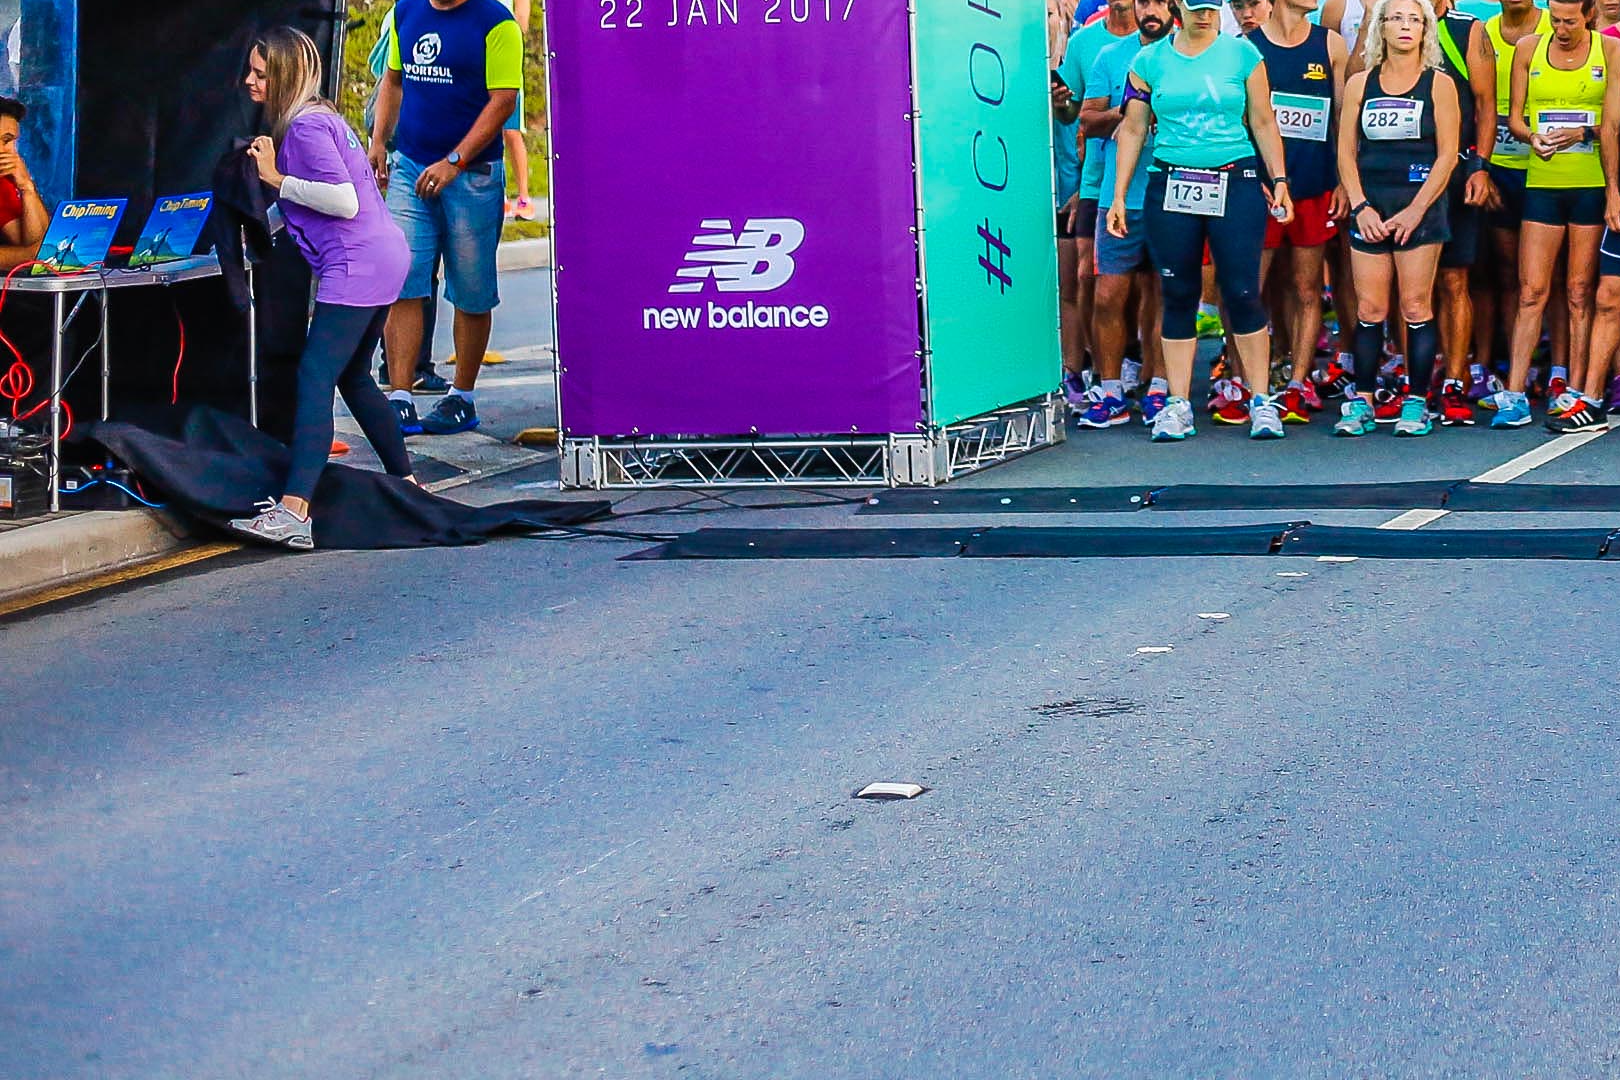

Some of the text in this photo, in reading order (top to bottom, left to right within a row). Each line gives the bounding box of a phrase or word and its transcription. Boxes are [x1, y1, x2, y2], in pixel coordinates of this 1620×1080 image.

[1367, 112, 1399, 128] 282
[1496, 126, 1522, 145] 52
[1172, 183, 1203, 202] 173
[642, 299, 830, 330] new balance
